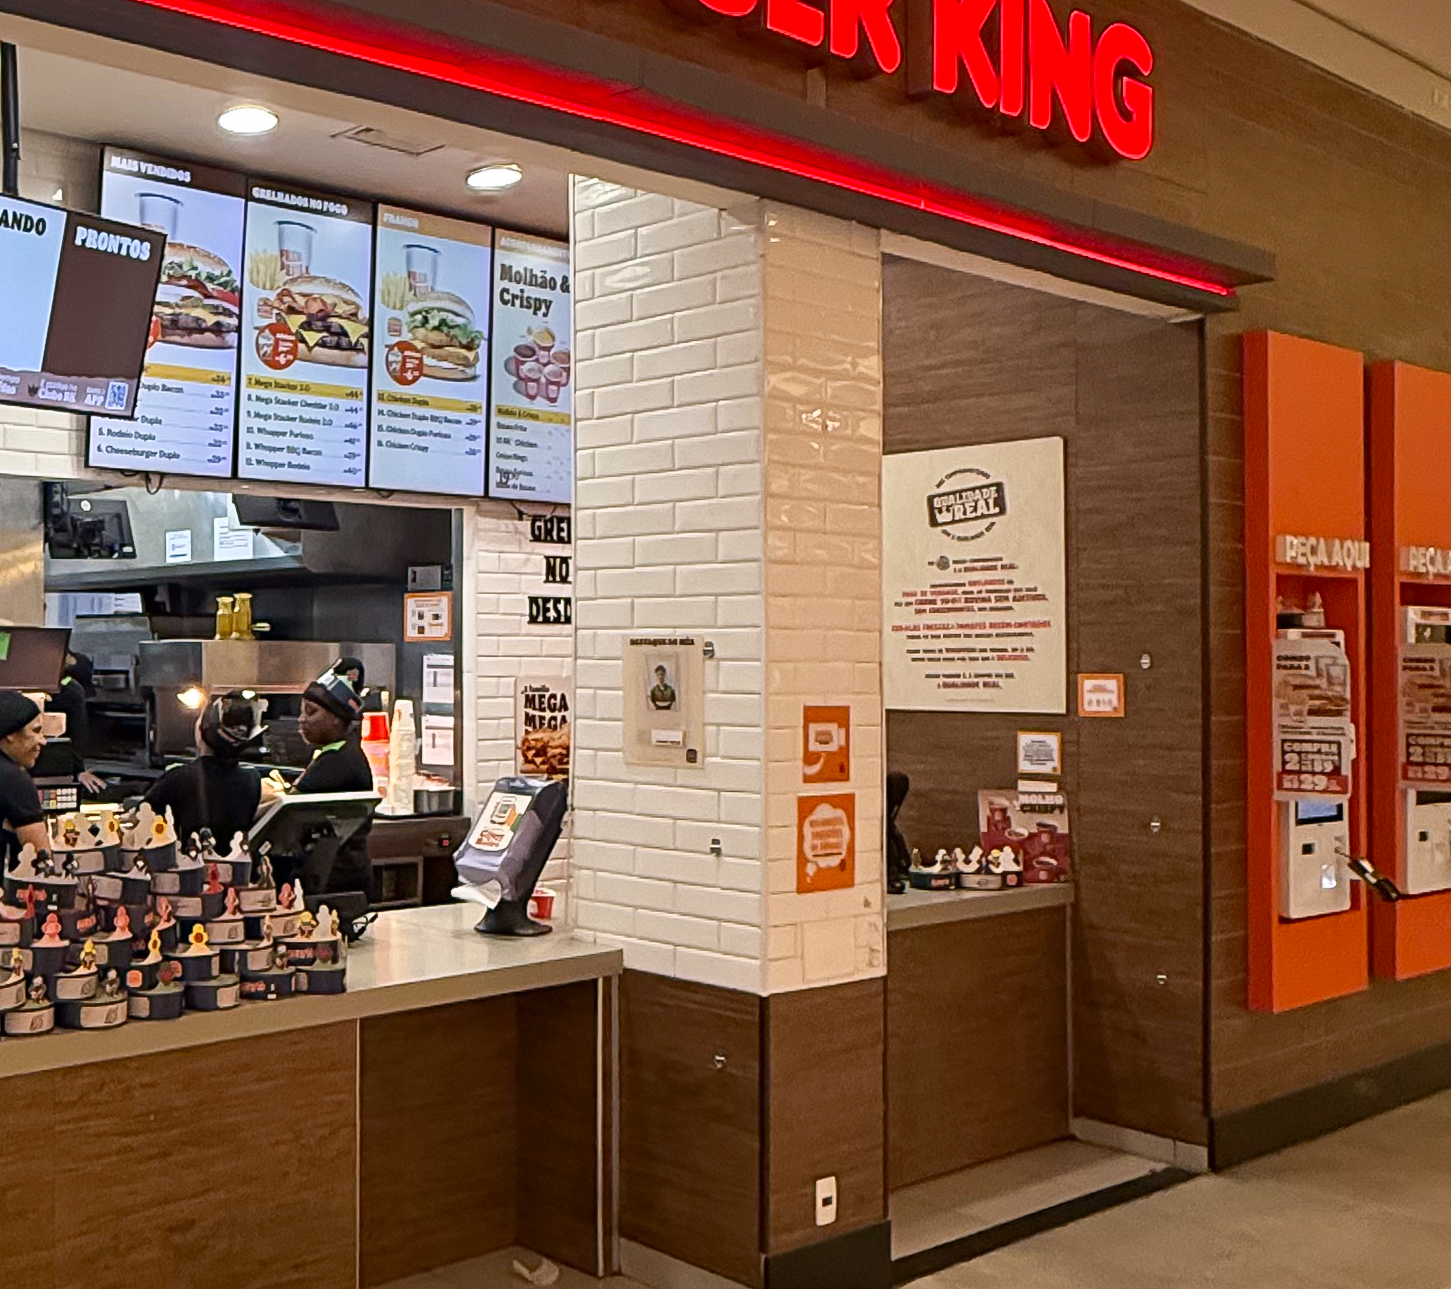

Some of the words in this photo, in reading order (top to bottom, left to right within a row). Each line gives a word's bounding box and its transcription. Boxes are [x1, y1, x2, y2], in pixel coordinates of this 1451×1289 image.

[74, 226, 151, 261] PRONTOS
[500, 263, 557, 291] Molhão
[499, 287, 554, 317] Crispy
[954, 498, 1000, 520] REAL
[1284, 535, 1329, 571] PEÇA
[1331, 539, 1370, 571] AQUI
[543, 556, 571, 584] NO
[524, 693, 569, 713] MEGA
